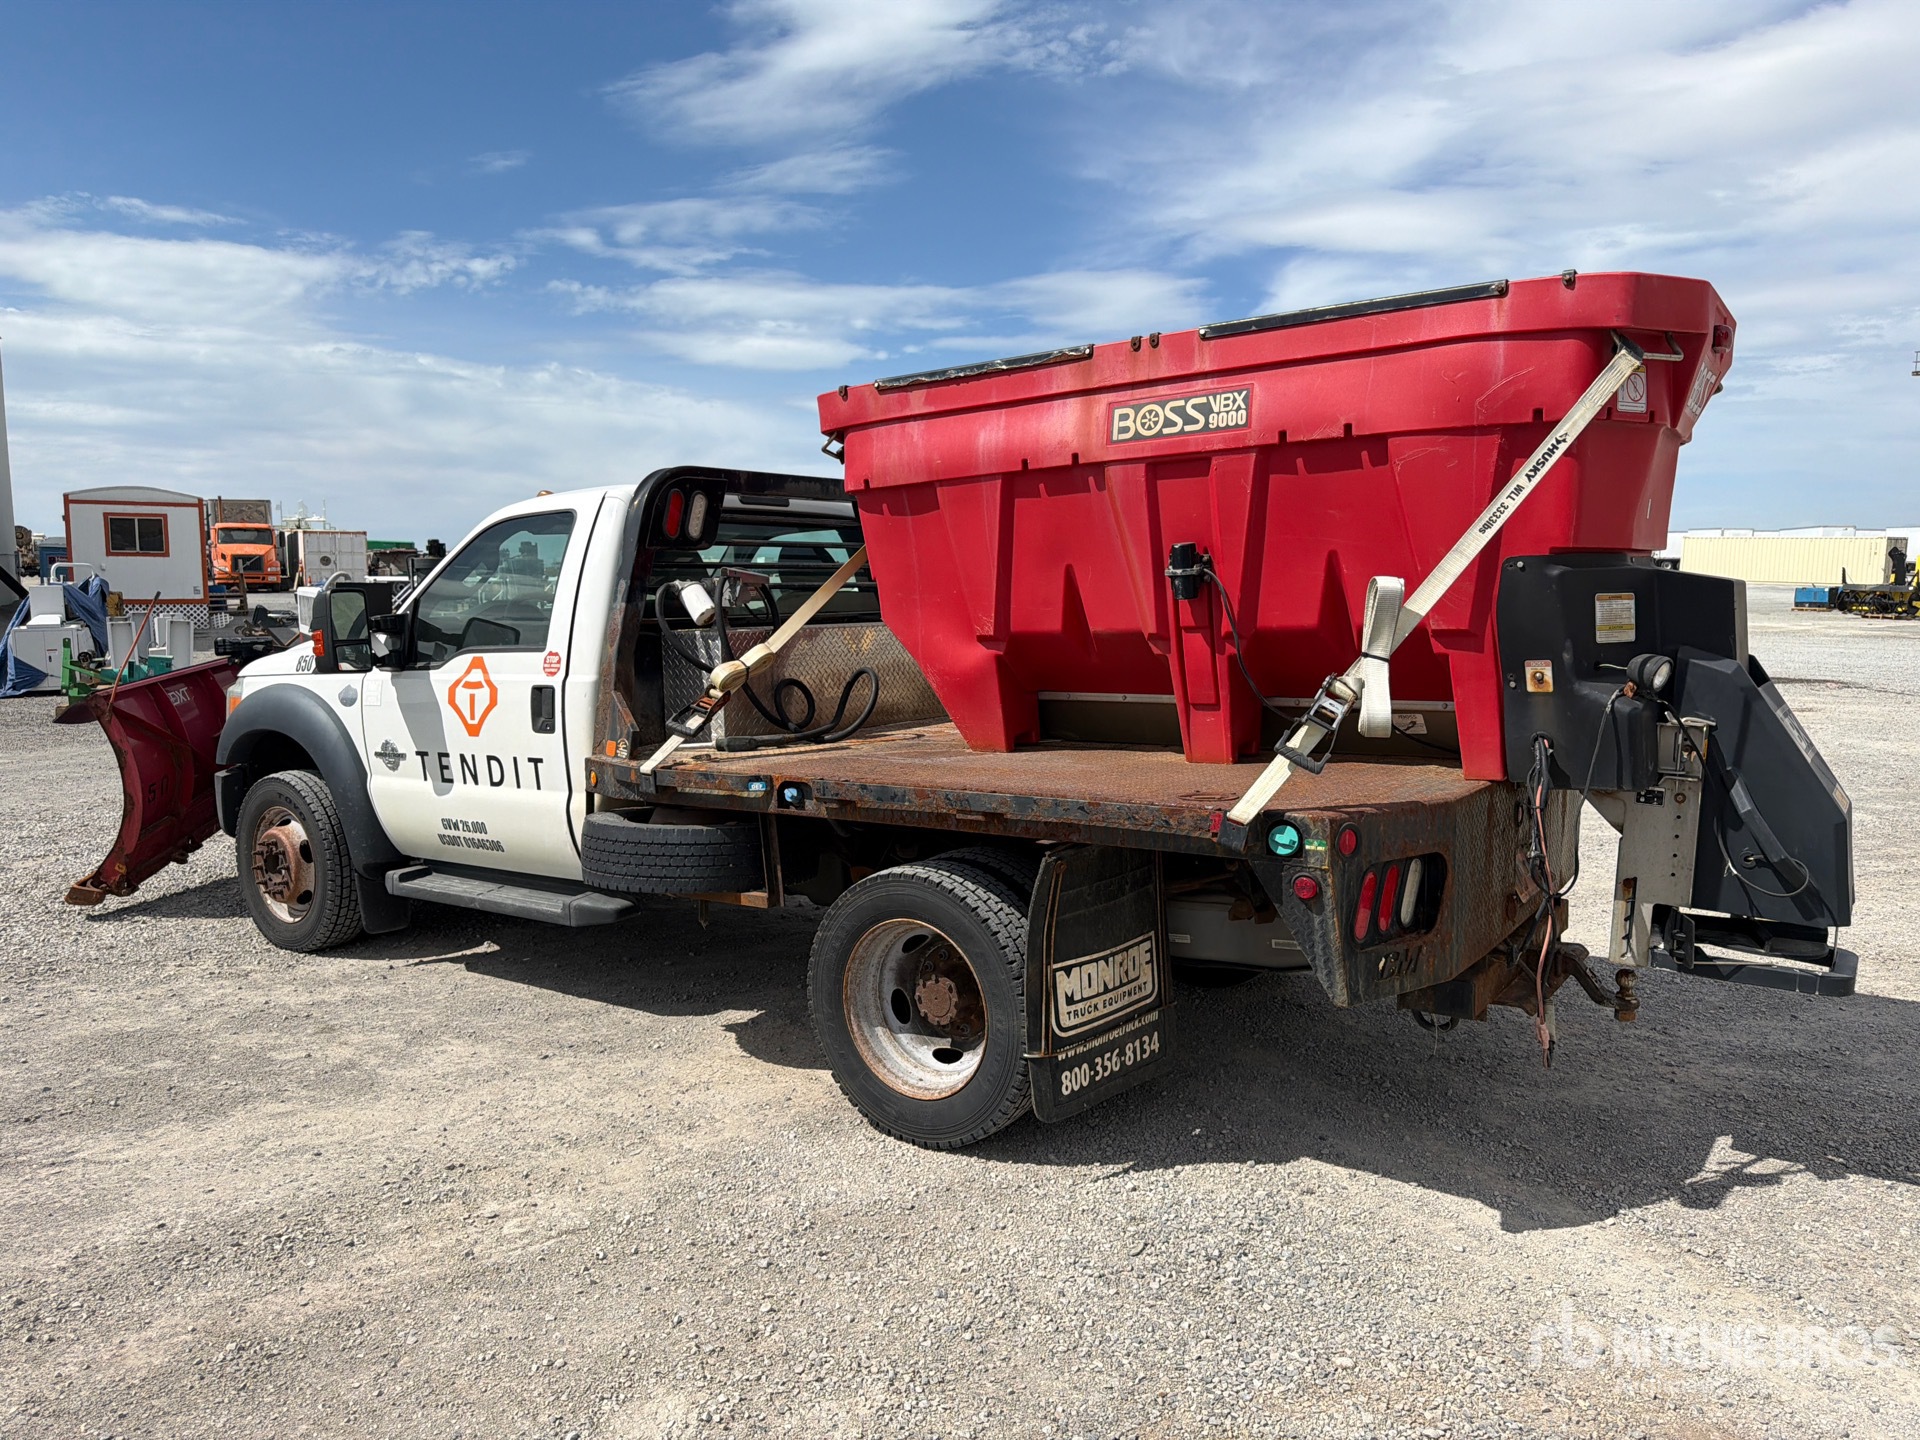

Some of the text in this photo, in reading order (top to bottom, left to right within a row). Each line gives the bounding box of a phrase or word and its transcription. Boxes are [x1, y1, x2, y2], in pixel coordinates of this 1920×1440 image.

[1112, 390, 1248, 441] BOSS VBX
[1208, 409, 1247, 429] 9000
[1479, 442, 1560, 534] HUSKY WLL 3333lbs
[295, 654, 315, 673] 850
[545, 655, 560, 664] STOP
[415, 750, 544, 791] TENDIT
[437, 833, 505, 853] USDOT 01646306
[441, 817, 460, 832] GVW
[1055, 940, 1153, 1002] MONROE
[1066, 981, 1148, 1022] TRUCK EQUIPMENT
[1061, 1031, 1160, 1096] 800-356-8134
